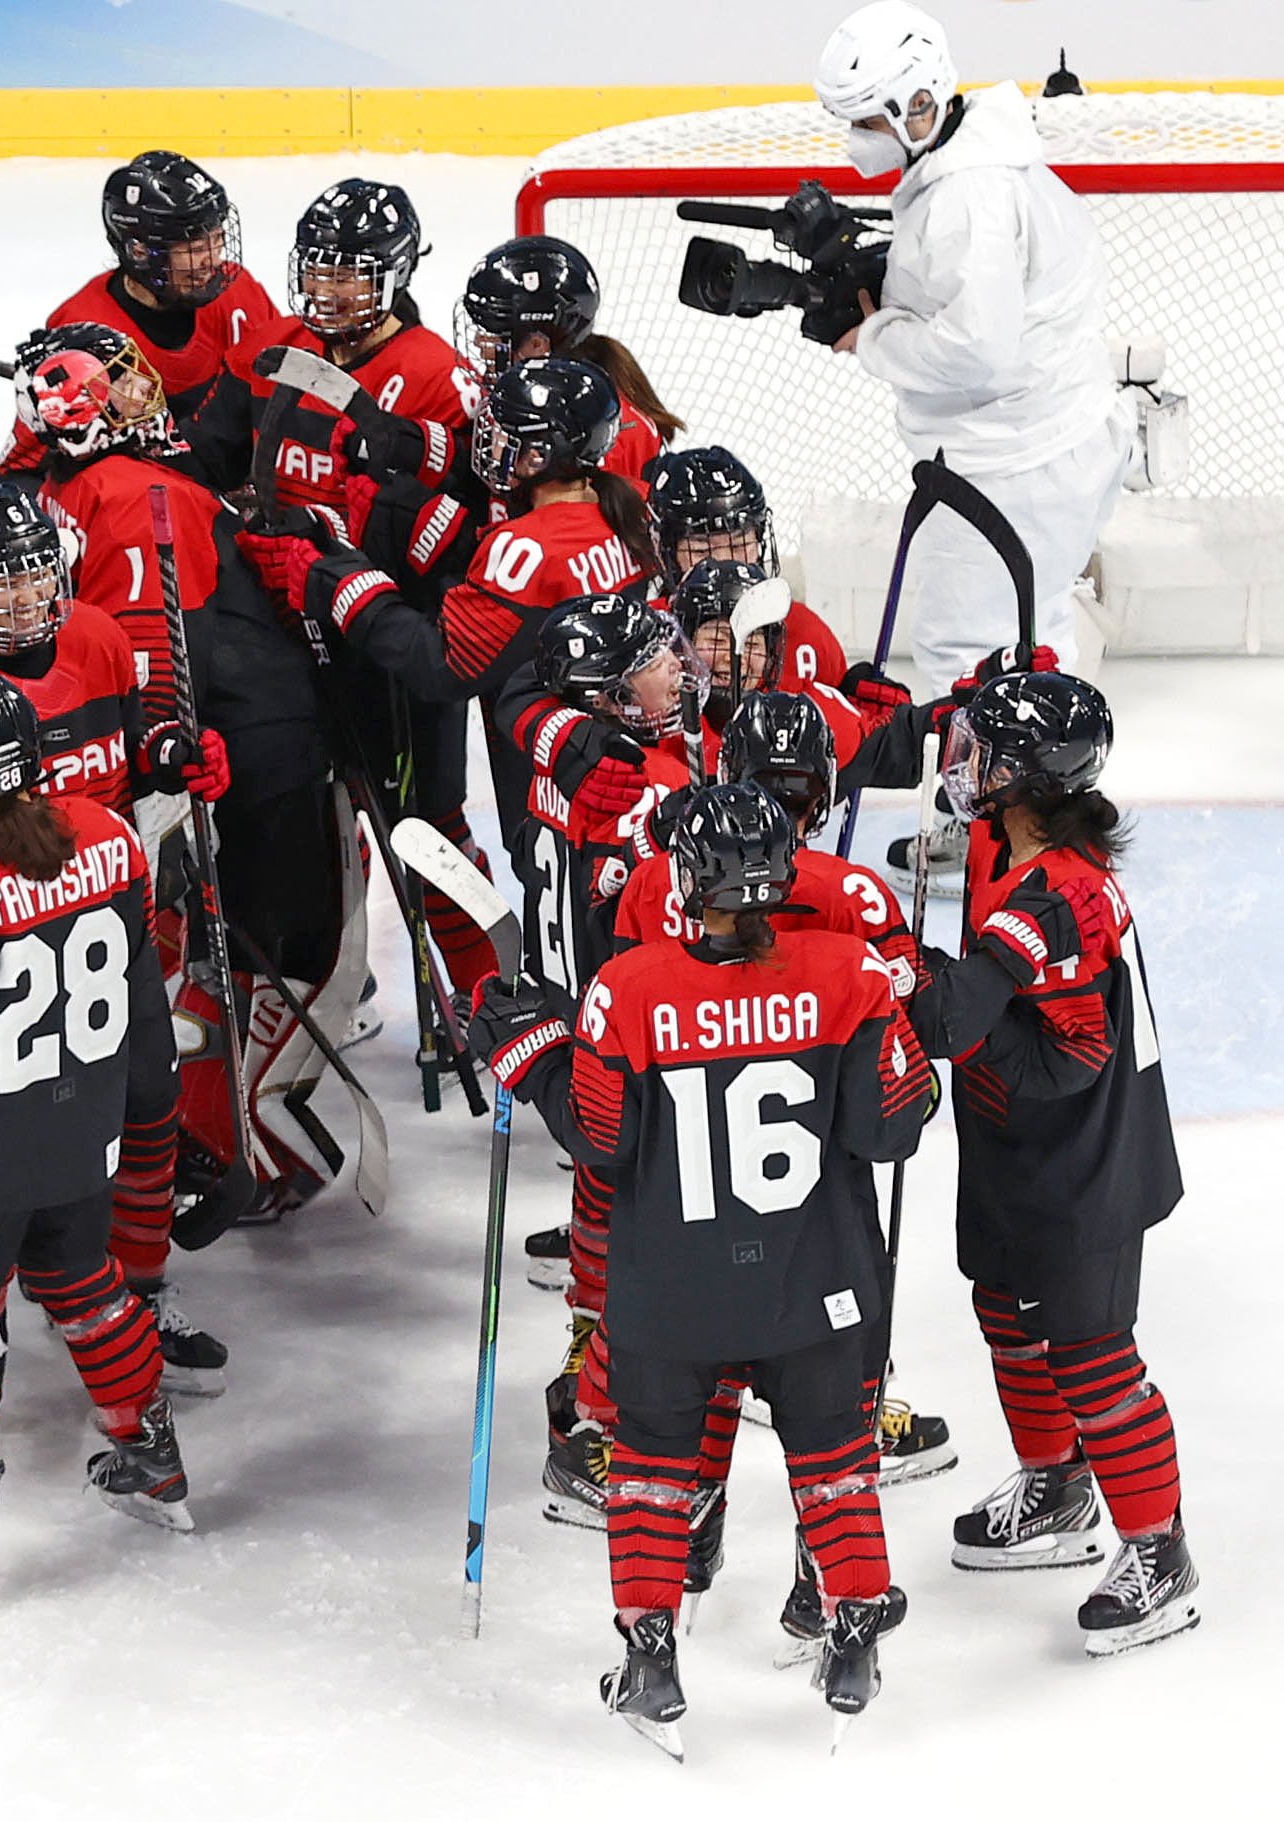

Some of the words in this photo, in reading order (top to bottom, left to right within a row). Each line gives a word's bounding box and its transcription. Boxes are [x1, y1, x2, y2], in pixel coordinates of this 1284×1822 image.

[519, 312, 555, 321] CCM
[378, 374, 405, 412] A
[123, 546, 145, 603] 1
[483, 531, 544, 593] 10
[796, 644, 816, 681] A
[775, 729, 789, 752] 3
[0, 766, 22, 792] 28
[38, 729, 126, 795] PAN
[741, 883, 771, 904] 16
[842, 873, 888, 926] 3
[660, 1060, 822, 1223] 16
